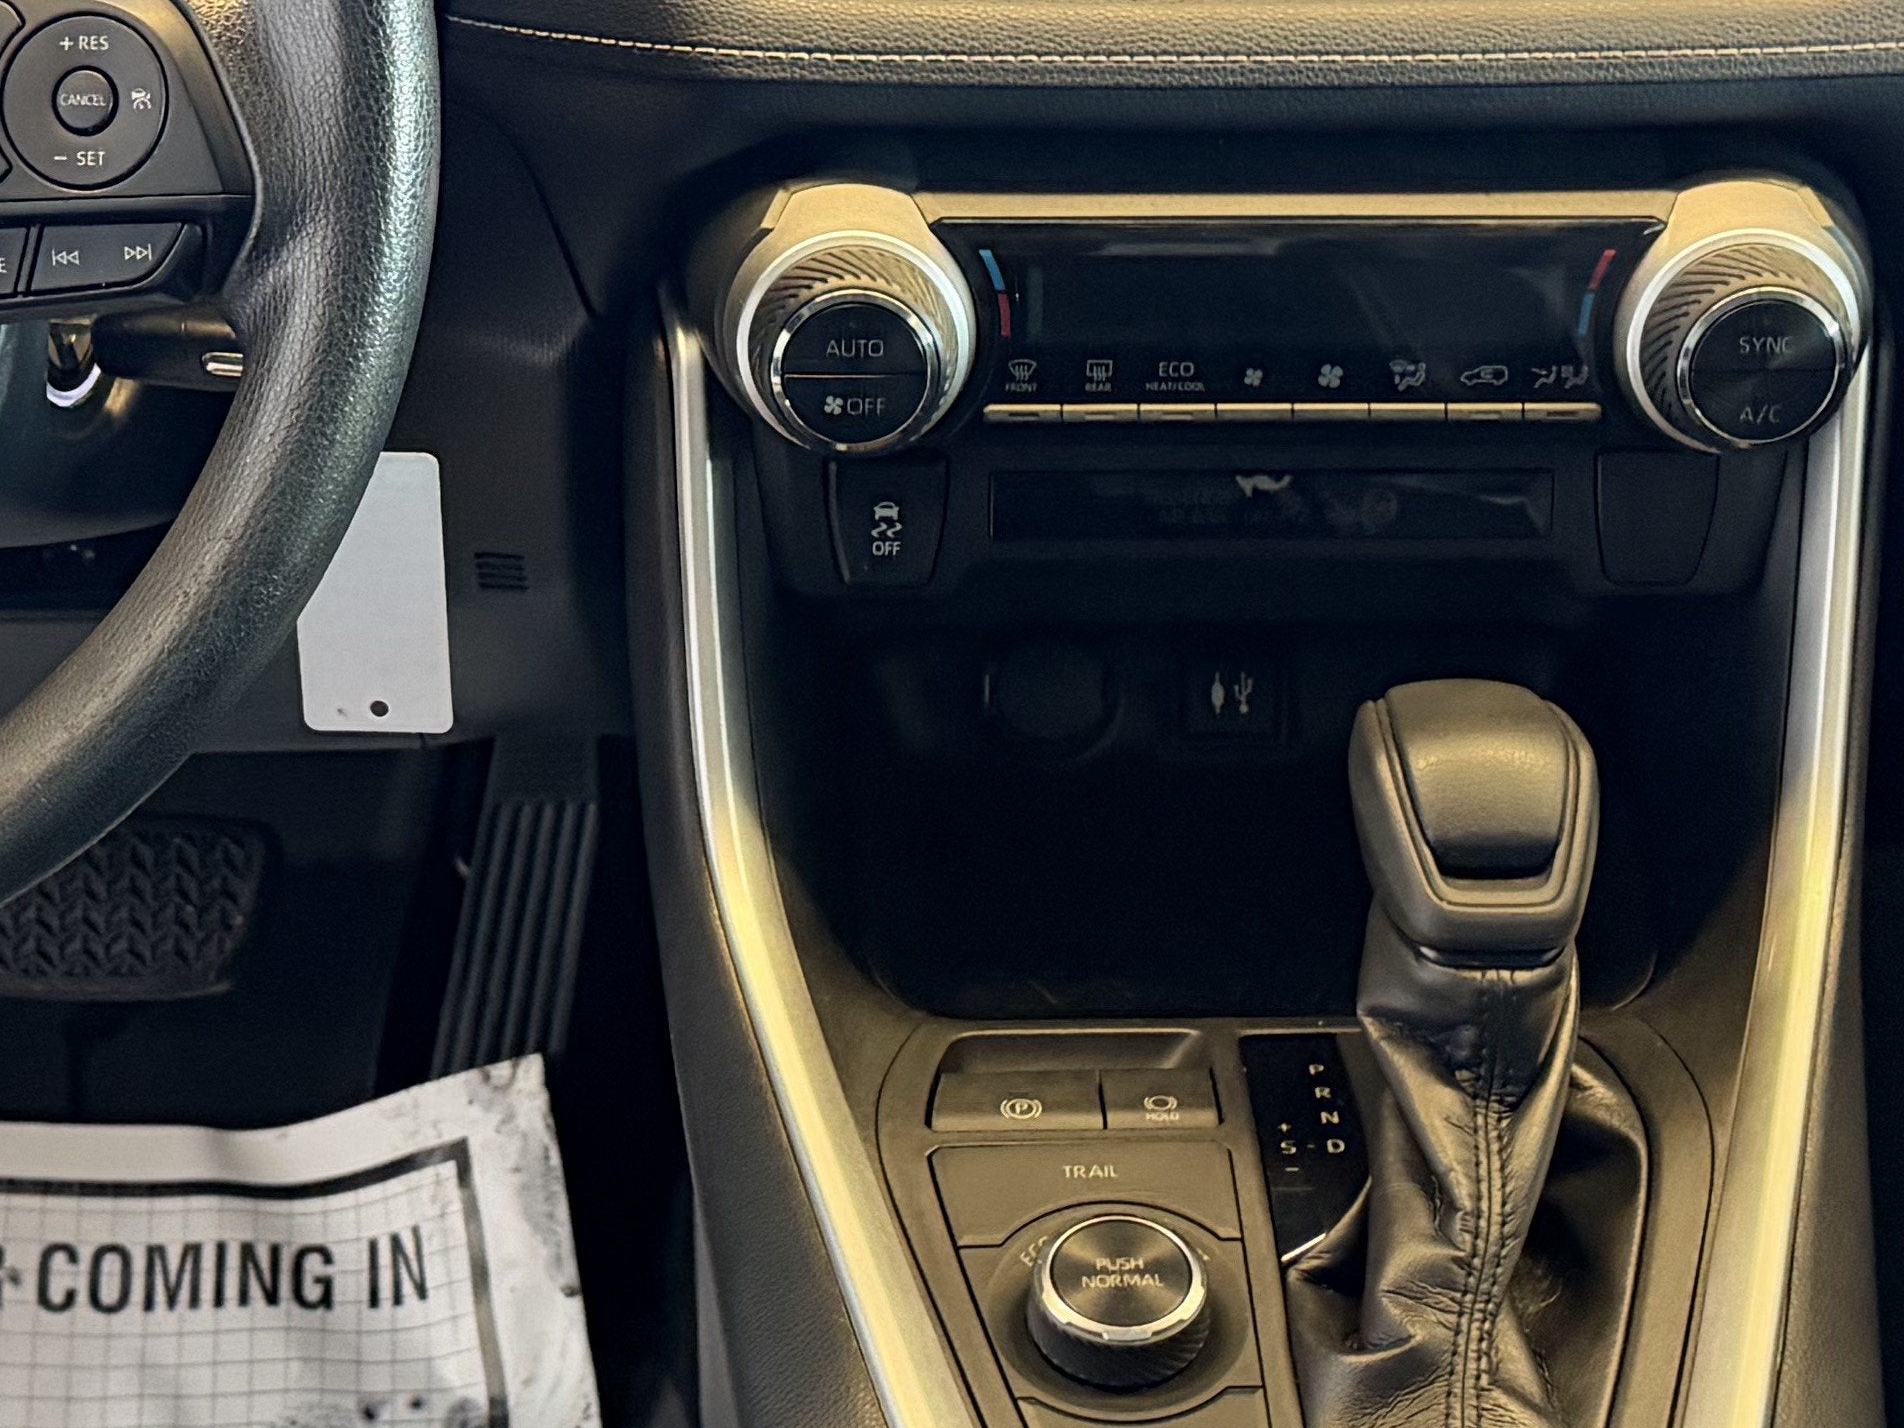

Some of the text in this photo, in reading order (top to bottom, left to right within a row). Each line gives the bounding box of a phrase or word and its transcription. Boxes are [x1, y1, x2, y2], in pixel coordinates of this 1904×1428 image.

[59, 94, 107, 107] CANCEL
[826, 339, 884, 358] AUTO
[1739, 336, 1793, 353] SYNC
[1159, 361, 1194, 377] ECO
[1005, 382, 1038, 392] FRONT
[1085, 382, 1112, 392] REAR
[847, 397, 885, 415] OFF
[1739, 404, 1780, 424] A/C
[872, 541, 901, 556] OFF
[1309, 1064, 1324, 1075] P
[1314, 1086, 1331, 1098] R
[1146, 1112, 1179, 1121] HOLD
[1320, 1111, 1340, 1124] N
[1280, 1140, 1297, 1154] S
[1326, 1138, 1345, 1153] D
[1062, 1164, 1118, 1178] TRAIL
[37, 1240, 335, 1315] COMING
[367, 1224, 430, 1310] IN
[1095, 1257, 1145, 1272] PUSH
[1081, 1273, 1164, 1289] NORMAL
